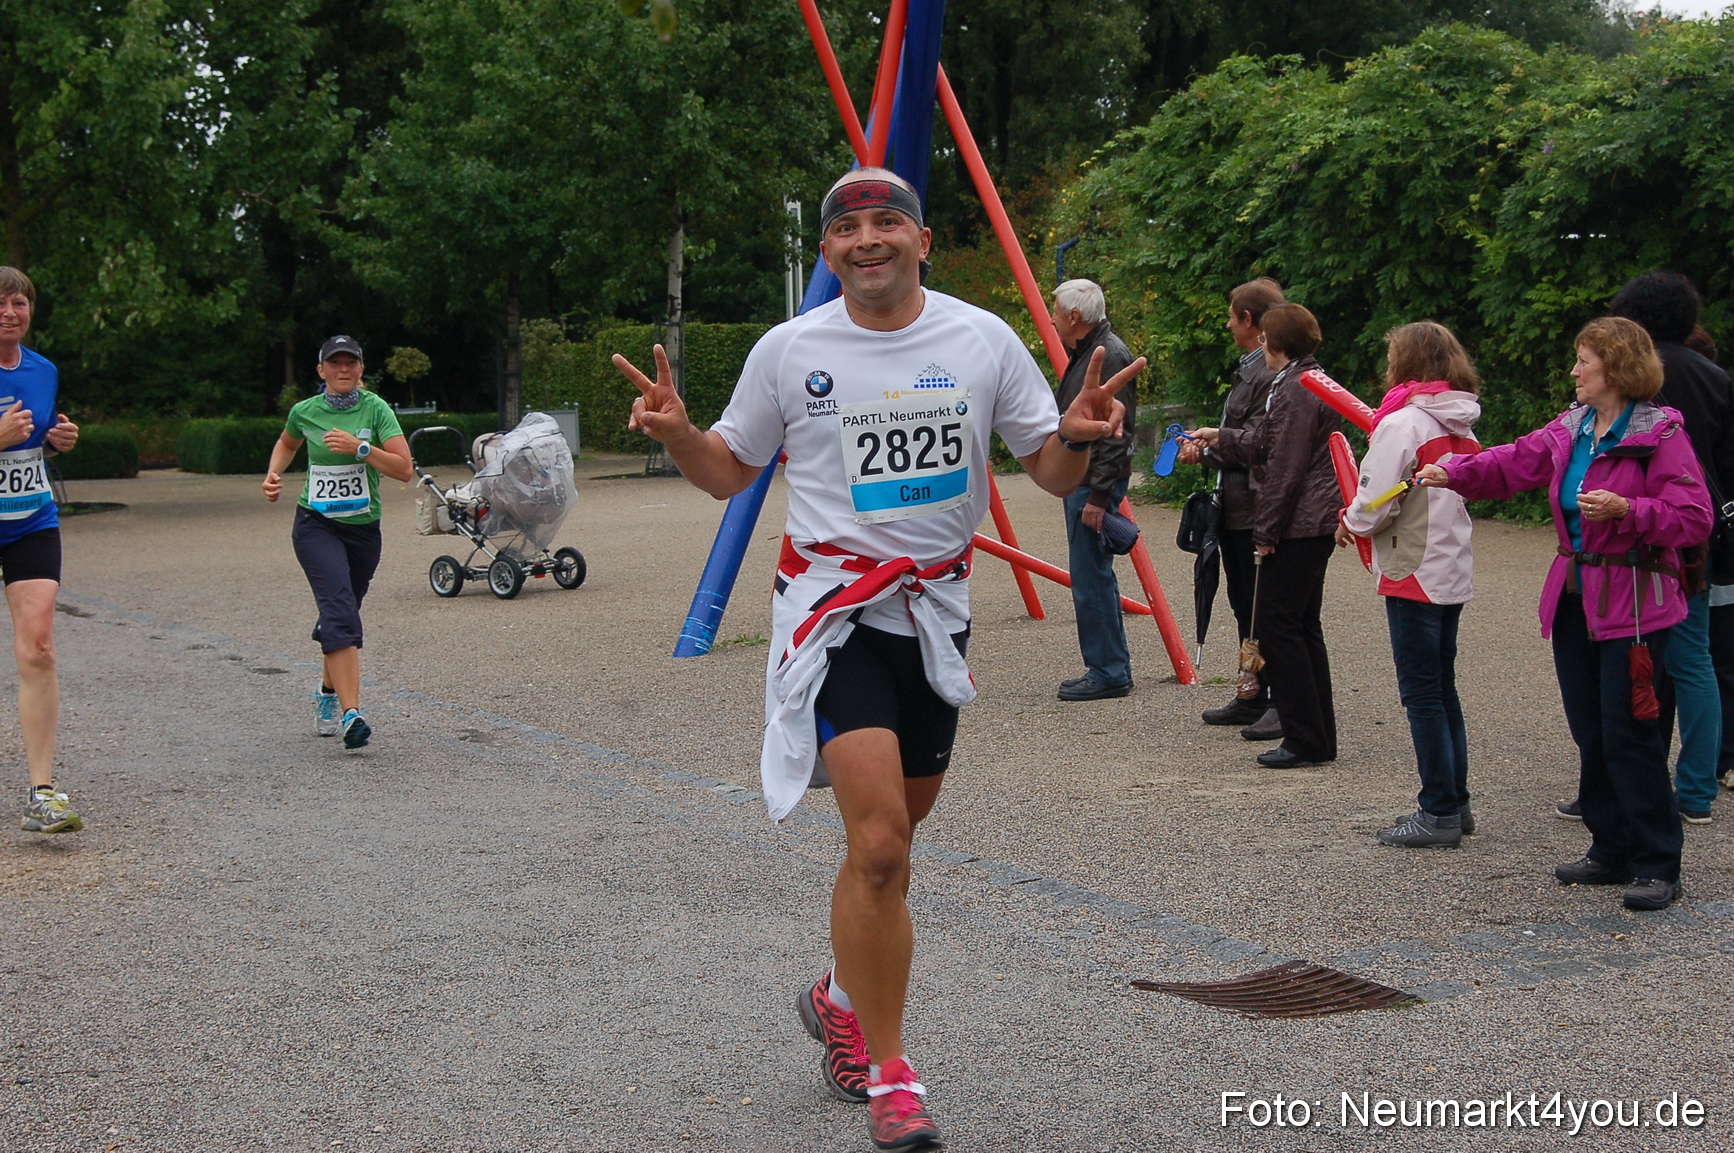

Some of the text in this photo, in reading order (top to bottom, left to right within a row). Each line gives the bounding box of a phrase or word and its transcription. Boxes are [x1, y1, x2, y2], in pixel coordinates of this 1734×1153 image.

[806, 399, 838, 411] PARTL
[808, 409, 840, 418] Neumark
[842, 406, 951, 427] PARTL Neumarkt
[857, 422, 962, 477] 2825
[0, 465, 44, 493] 2624
[316, 477, 363, 498] 2253
[900, 484, 930, 502] Can
[0, 496, 42, 510] Hildegard
